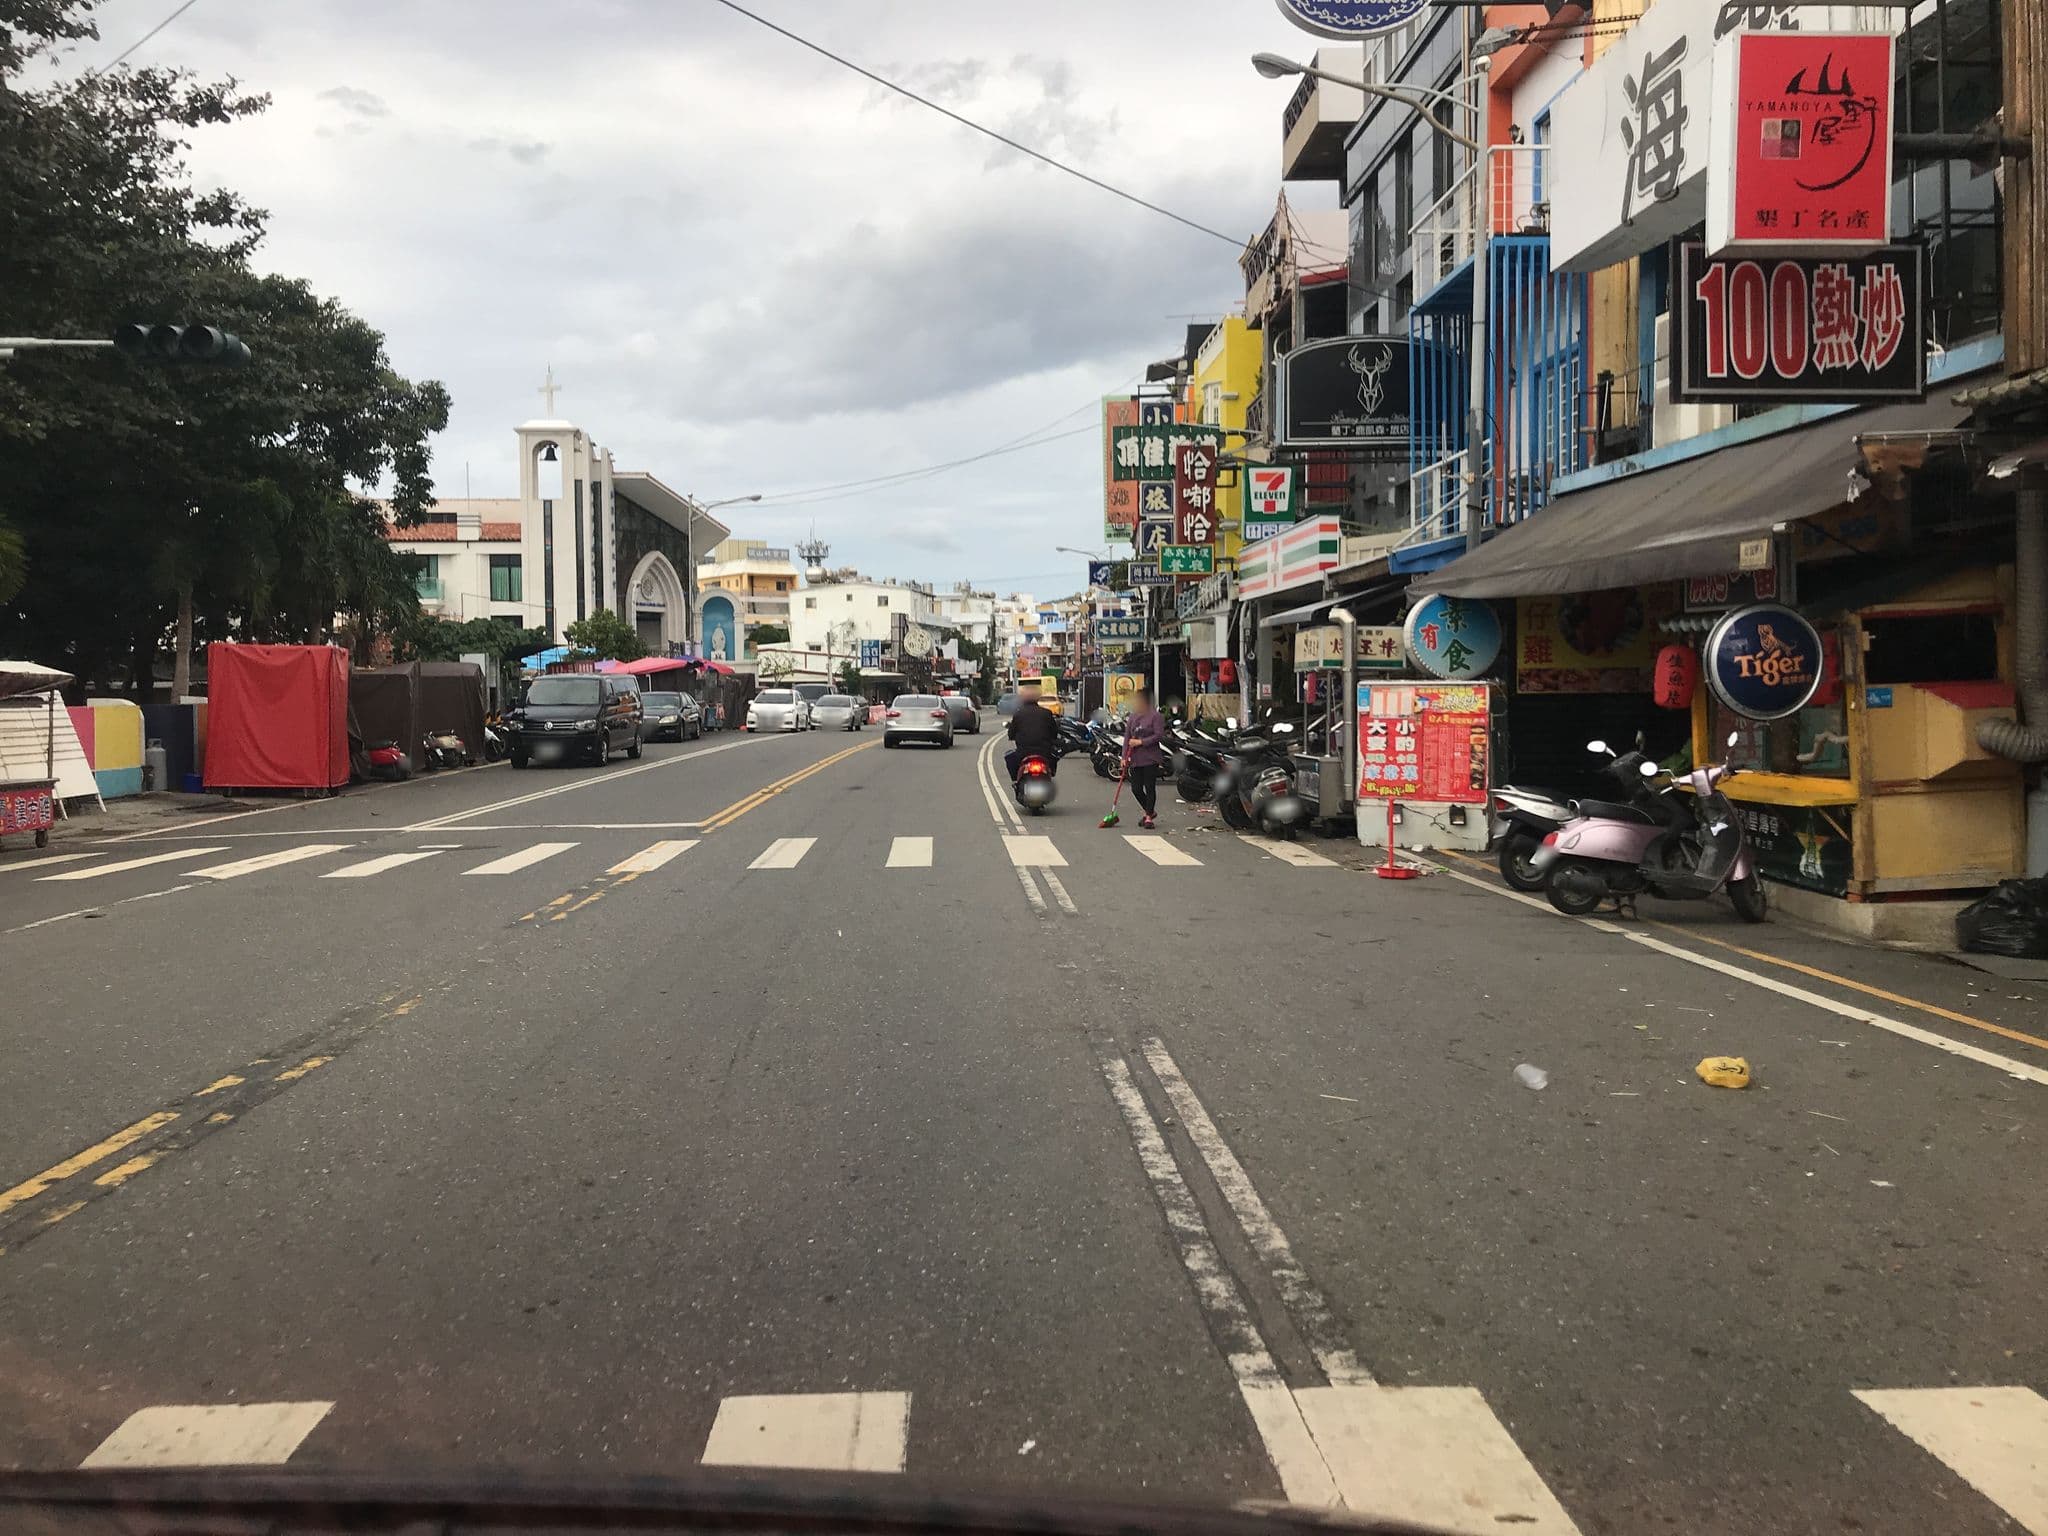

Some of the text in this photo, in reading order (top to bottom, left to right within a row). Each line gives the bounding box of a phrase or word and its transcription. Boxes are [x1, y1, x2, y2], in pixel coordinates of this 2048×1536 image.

[1745, 101, 1833, 113] YAMANOYA
[1696, 259, 1906, 381] 100熱炒
[1183, 449, 1212, 542] 恰嘟恰
[1255, 472, 1285, 513] 7
[1419, 624, 1440, 650] 有
[1734, 649, 1805, 687] Tiger
